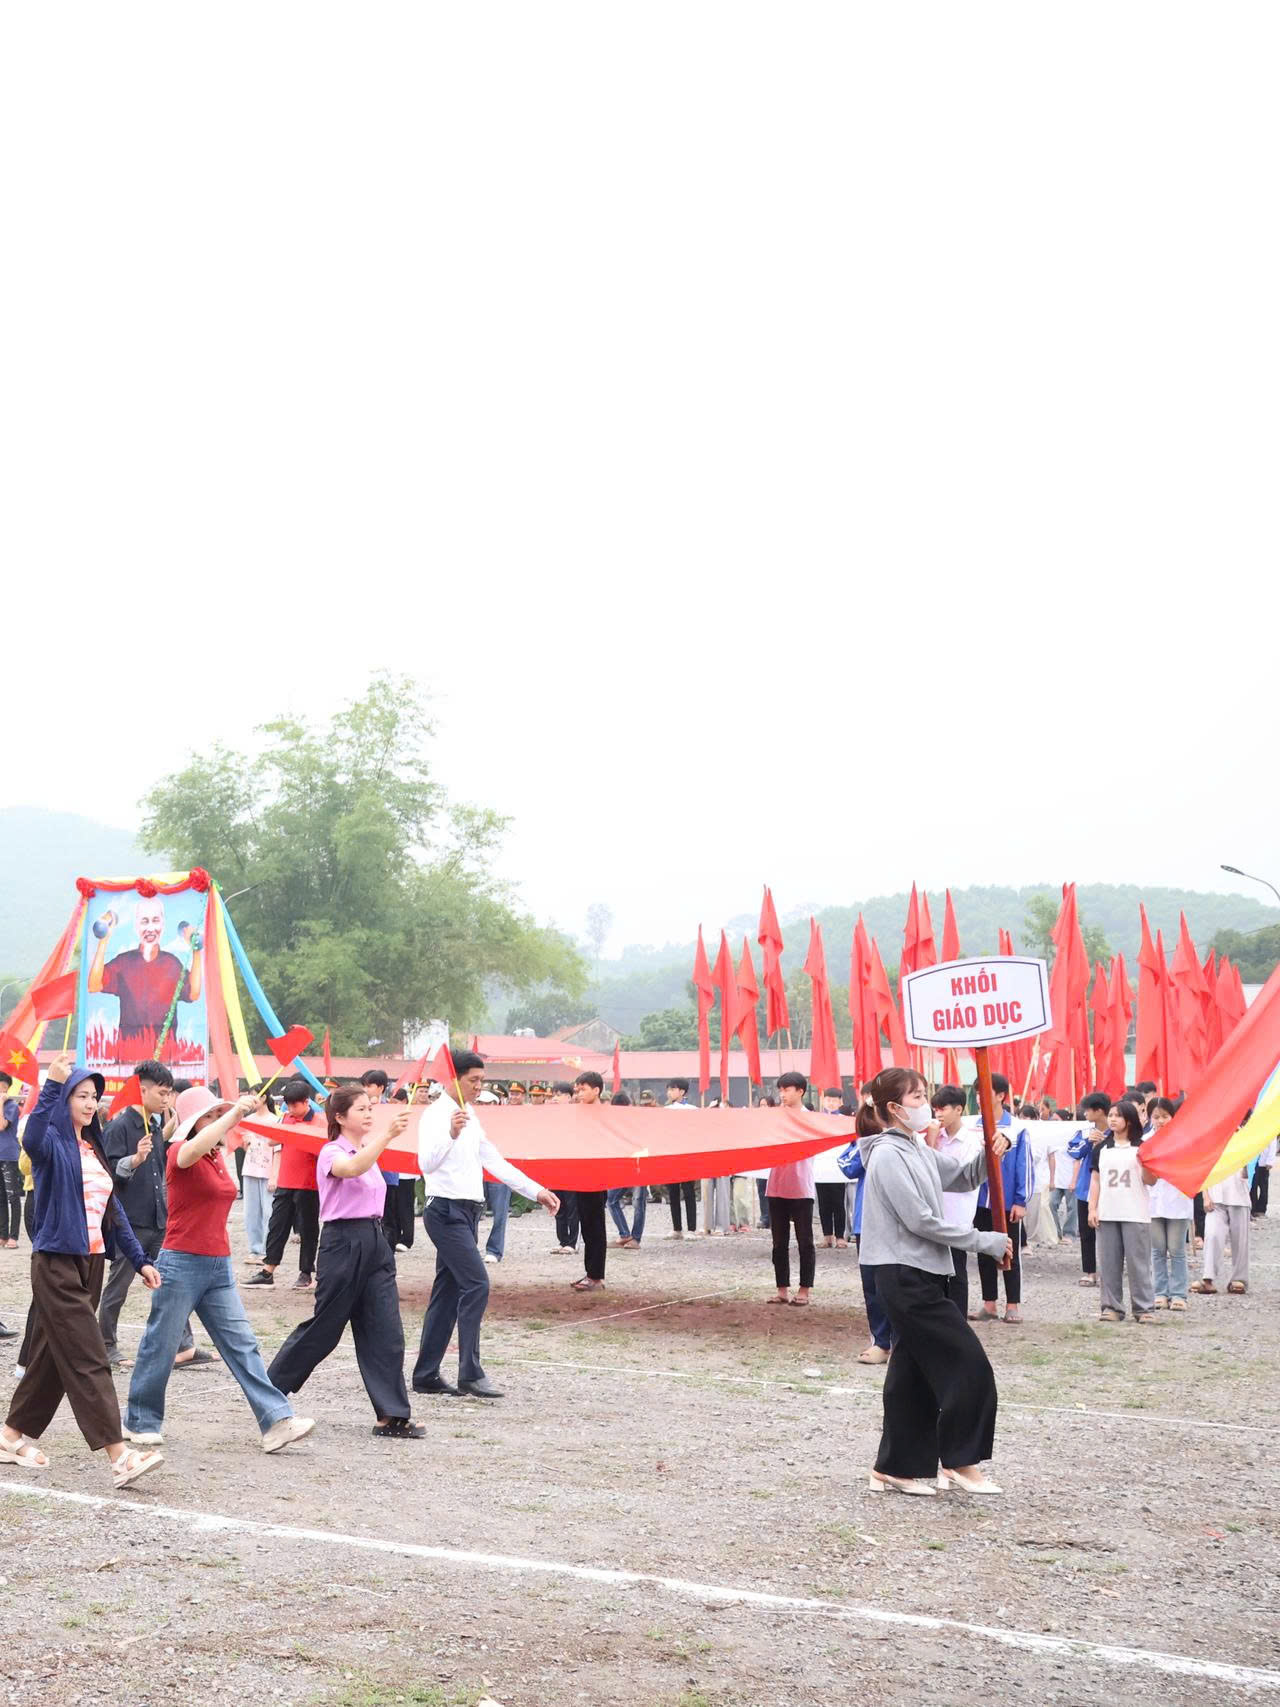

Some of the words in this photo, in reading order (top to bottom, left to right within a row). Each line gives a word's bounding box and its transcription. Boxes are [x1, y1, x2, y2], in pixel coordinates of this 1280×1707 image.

[951, 967, 998, 996] KHỐI
[932, 1002, 978, 1032] GIÁO
[983, 1000, 1023, 1030] DỤC
[1108, 1169, 1131, 1187] 24
